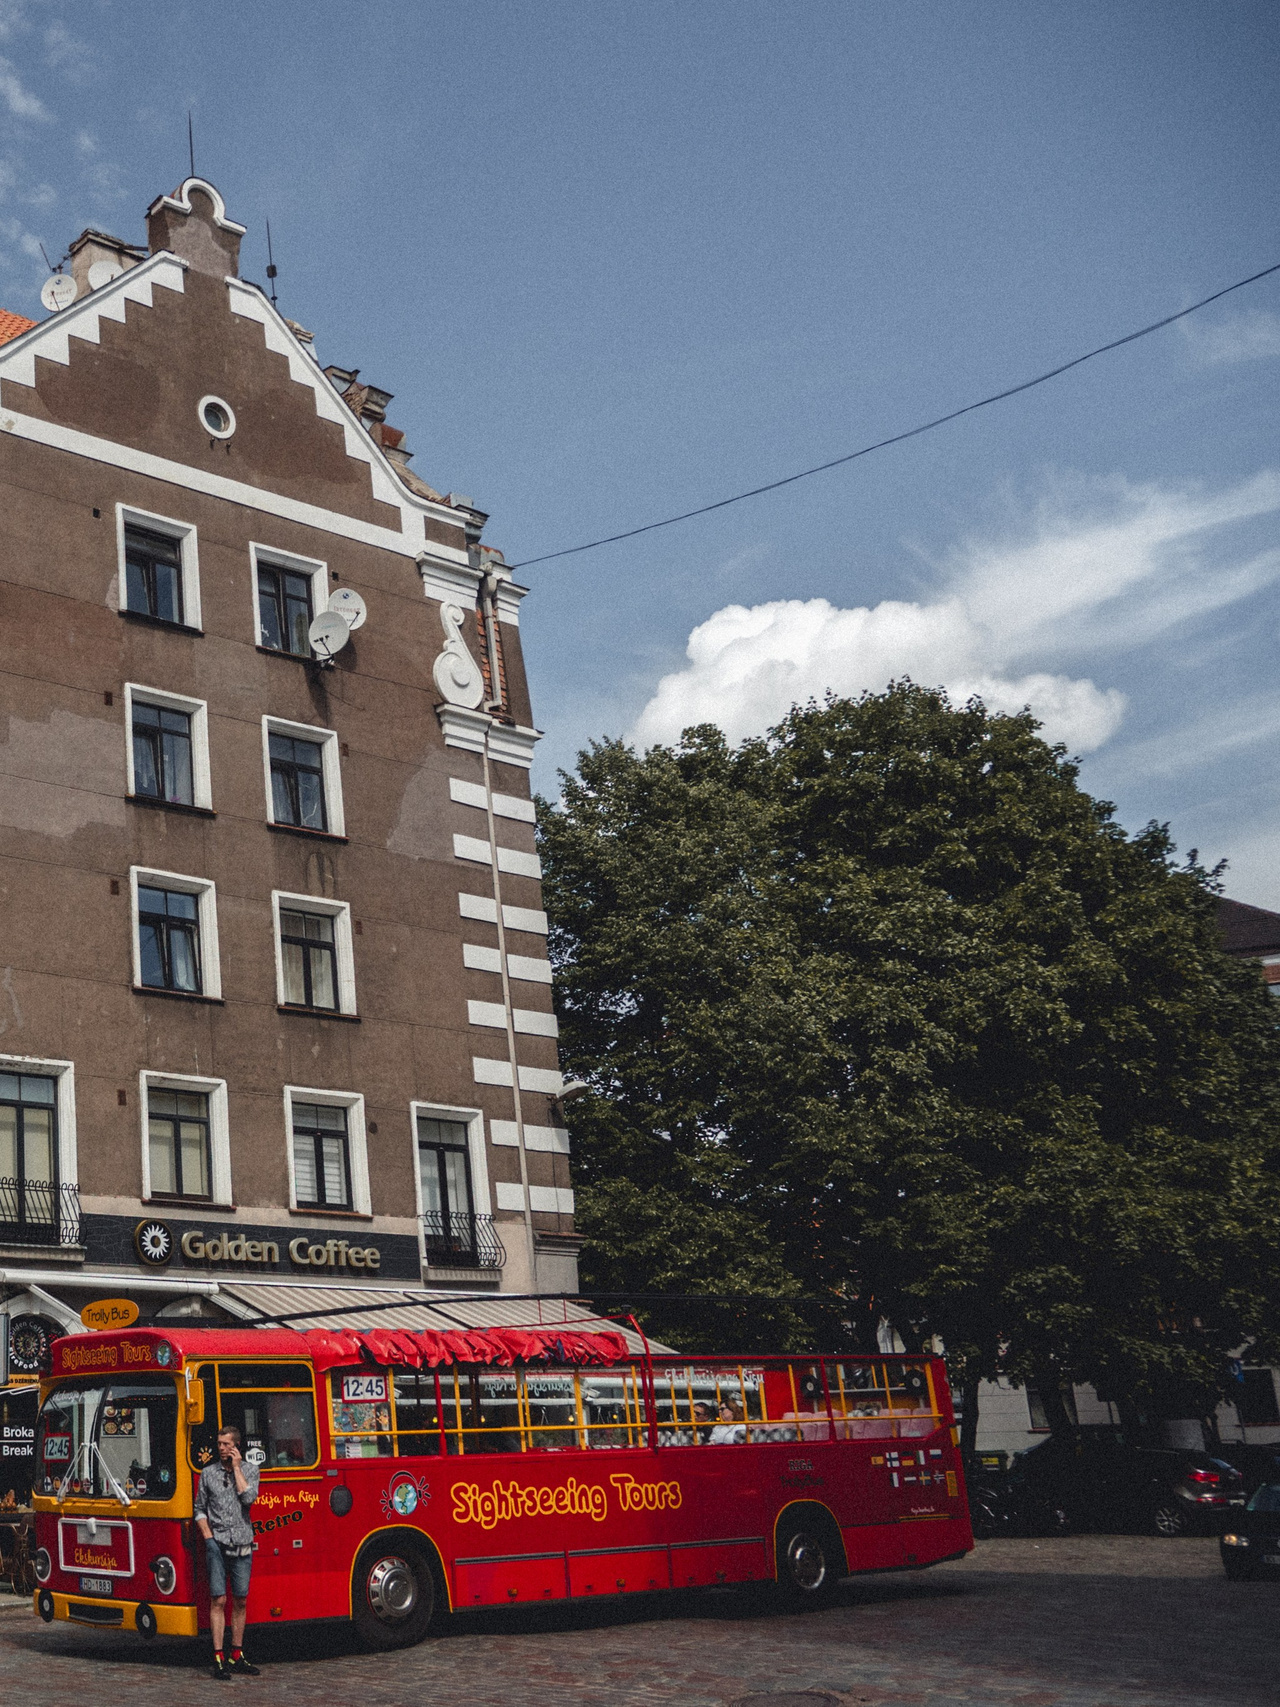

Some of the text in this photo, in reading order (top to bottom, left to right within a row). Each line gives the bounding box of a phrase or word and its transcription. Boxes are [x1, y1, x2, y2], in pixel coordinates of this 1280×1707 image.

[181, 1230, 381, 1269] Golden Coffee
[86, 1307, 130, 1324] Trolly Bus
[61, 1341, 152, 1370] Sightseeing Tours
[343, 1378, 384, 1397] 12:45
[45, 1438, 69, 1457] 12:45
[283, 1495, 297, 1508] pa
[298, 1489, 320, 1509] Rīgu
[450, 1473, 683, 1530] Sightseeing Tours
[251, 1510, 303, 1536] Retro
[74, 1548, 118, 1571] Ekskursija
[83, 1581, 111, 1592] HD-1883
